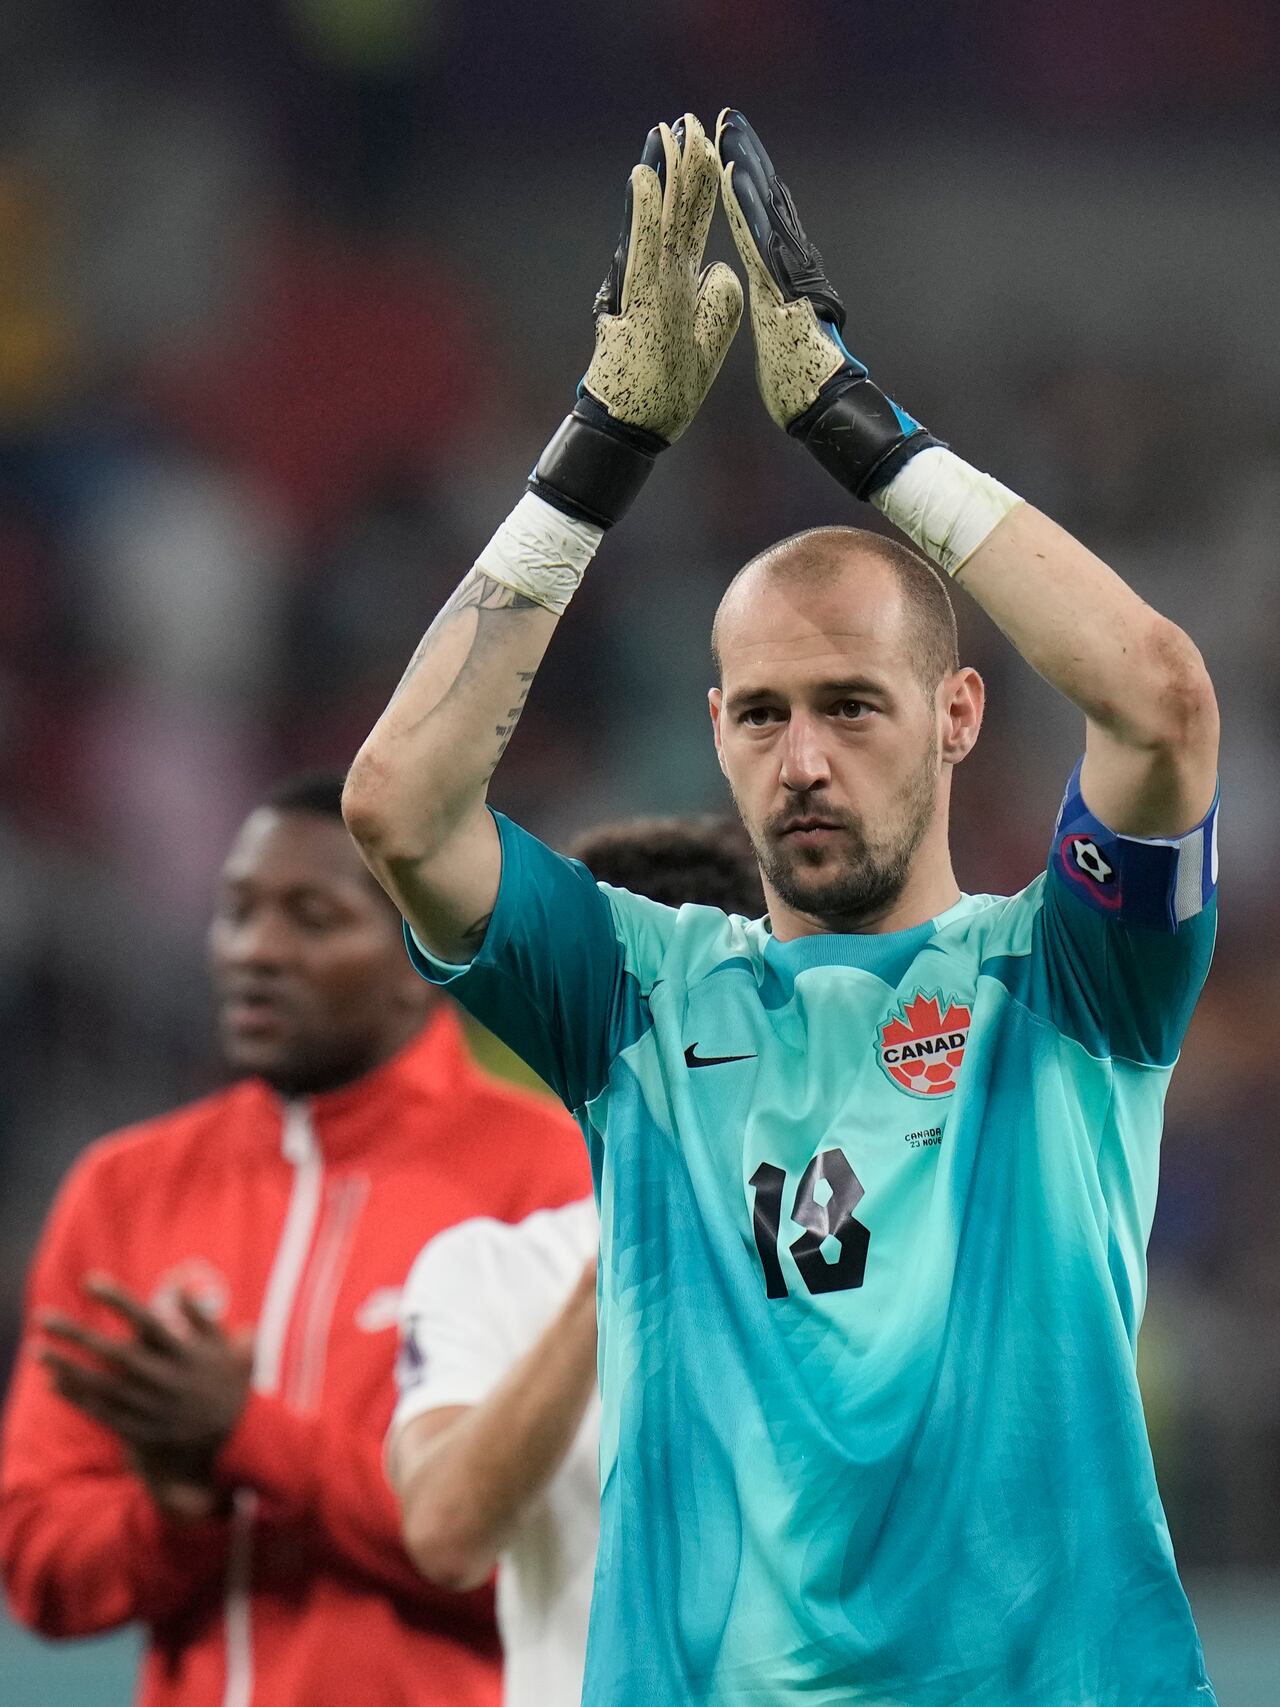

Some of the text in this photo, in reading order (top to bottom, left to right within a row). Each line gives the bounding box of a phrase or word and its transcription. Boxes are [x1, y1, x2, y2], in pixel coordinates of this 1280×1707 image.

[883, 1033, 966, 1063] CANAD
[905, 1127, 942, 1141] CANADA
[910, 1136, 942, 1148] 23 NOVE
[749, 1148, 871, 1300] 18
